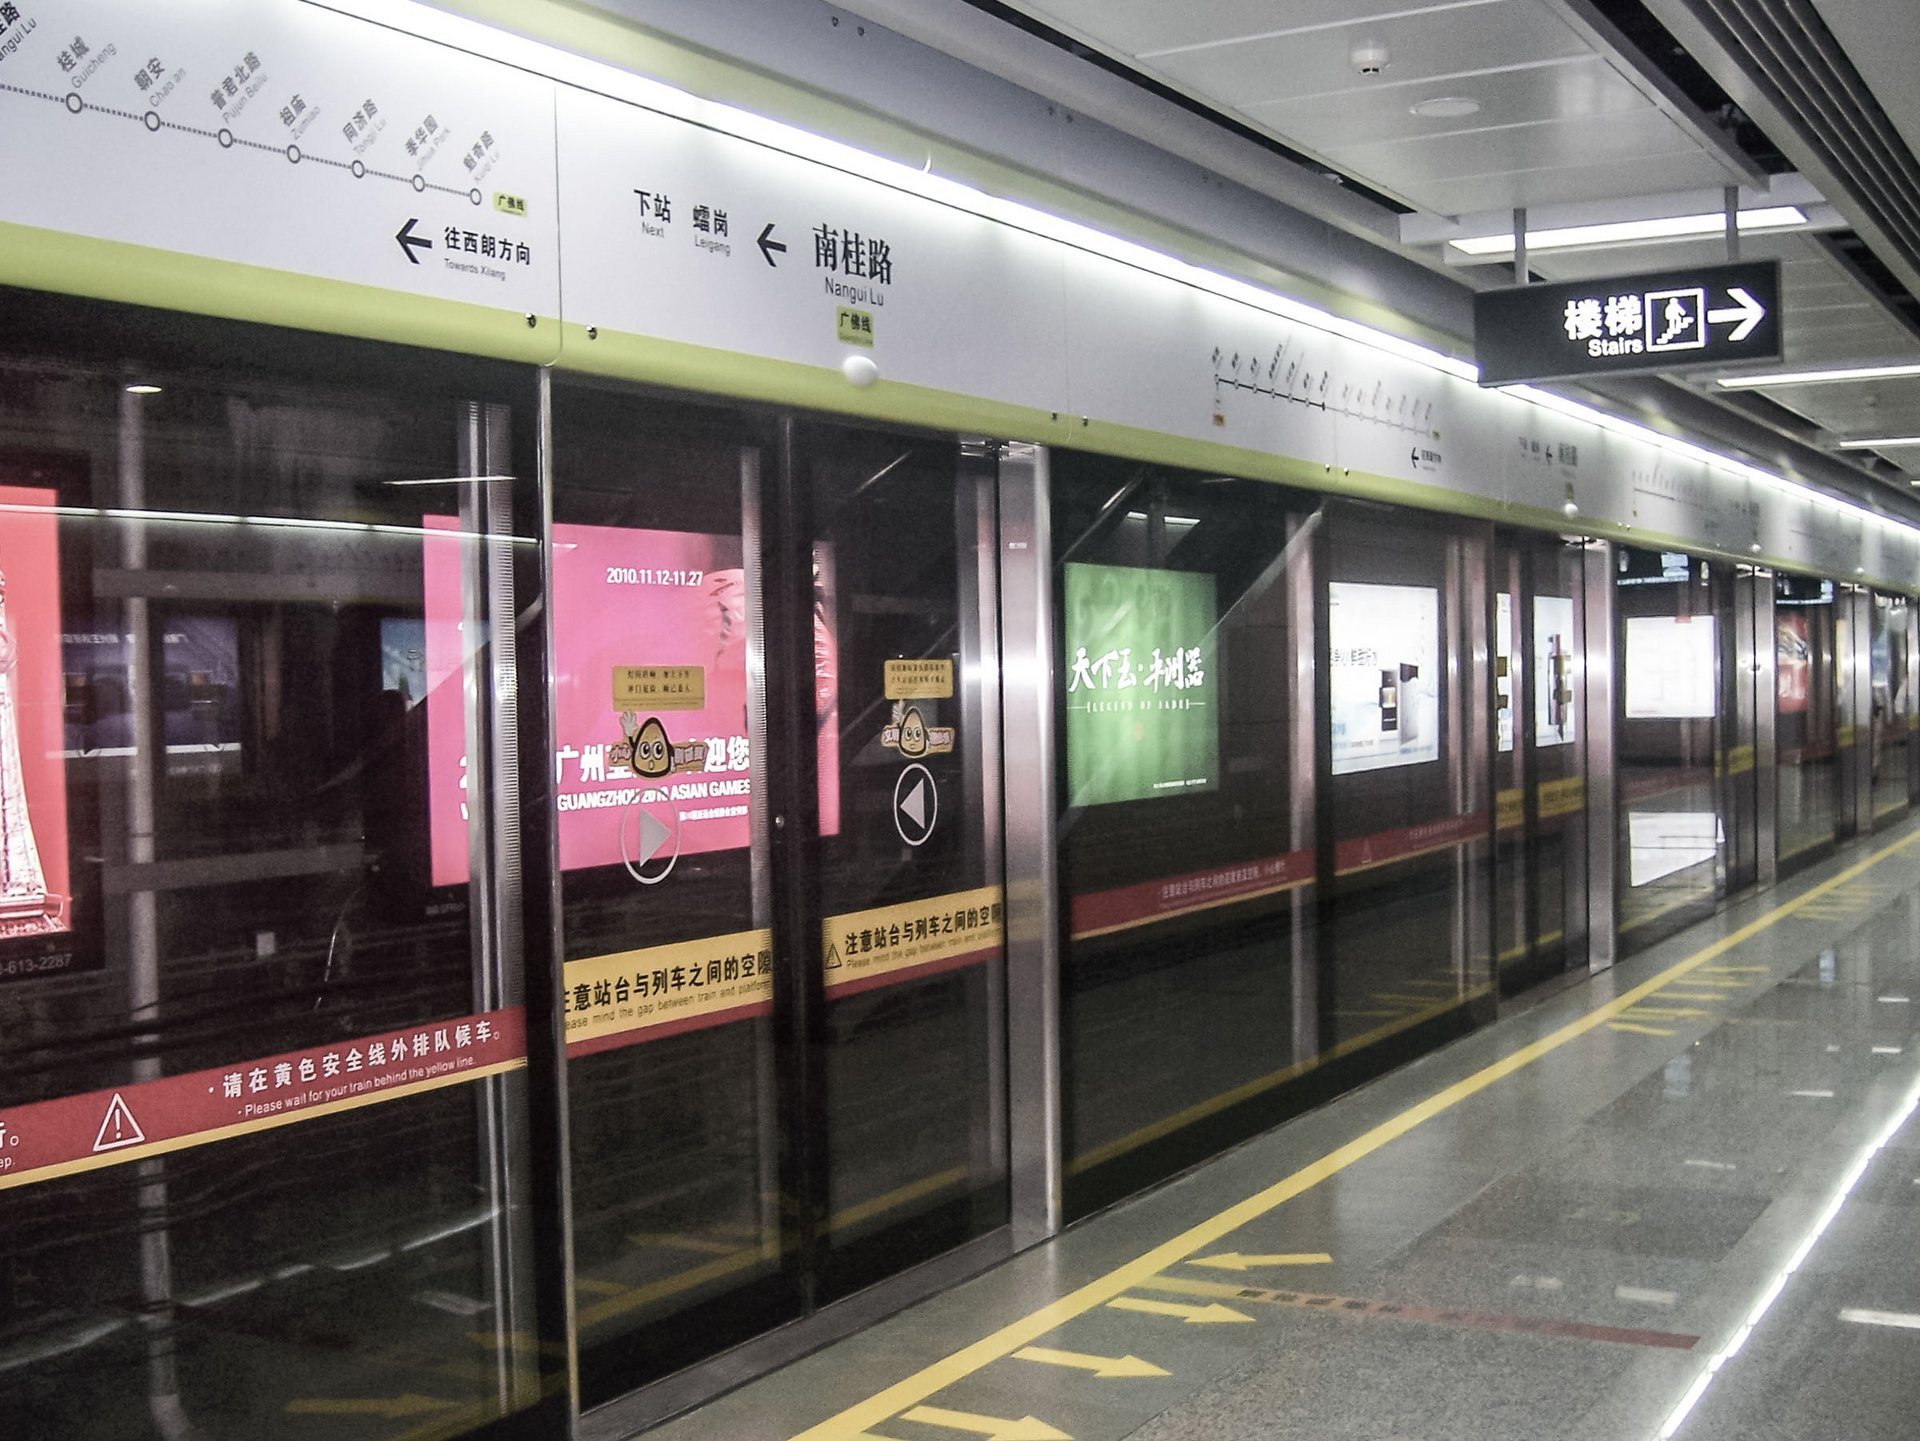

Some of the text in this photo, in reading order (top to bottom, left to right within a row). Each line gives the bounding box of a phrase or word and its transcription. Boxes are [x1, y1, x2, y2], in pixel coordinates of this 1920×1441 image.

[20, 17, 37, 35] Lu
[56, 35, 90, 72] 桂城
[70, 42, 117, 88] Guicheng
[133, 57, 165, 91] 朝安
[210, 51, 262, 110] 普君北路
[279, 94, 307, 127] 祖庙
[342, 98, 378, 144] 同济路
[633, 189, 671, 224] 下站
[444, 226, 531, 266] 往西朗方向
[641, 222, 665, 238] Next
[444, 257, 479, 274] Towards
[812, 222, 893, 286] 南桂路
[825, 276, 884, 306] Nangui Lu
[839, 311, 872, 334] 广佛线
[1563, 294, 1642, 340] 楼梯
[1588, 337, 1644, 358] Stairs
[606, 566, 704, 587] 2010.11.12-11.27
[557, 788, 640, 812] GUANGZHOU
[670, 782, 708, 801] ASIAN
[708, 779, 750, 798] GAMES
[620, 1006, 634, 1018] the
[637, 1003, 654, 1018] gap
[658, 995, 694, 1010] between
[720, 986, 736, 998] and
[223, 1021, 500, 1099] 请在黄色安全线外排队候车。
[245, 1100, 283, 1117] Please
[284, 1095, 307, 1109] wait
[309, 1090, 323, 1105] for
[325, 1086, 348, 1104] your
[350, 1080, 372, 1095] train
[374, 1070, 407, 1091] behind
[409, 1067, 424, 1082] the
[426, 1061, 455, 1081] yellow
